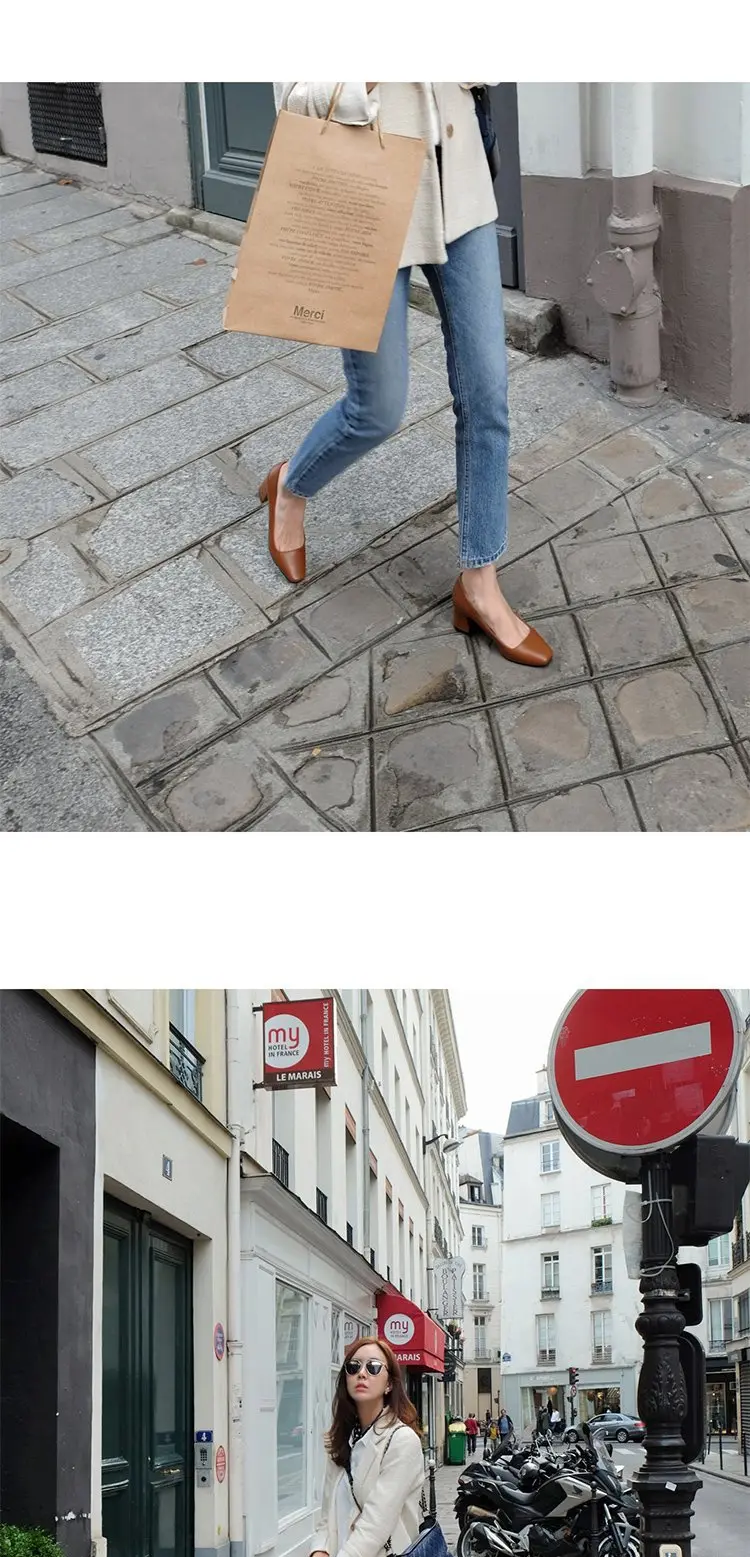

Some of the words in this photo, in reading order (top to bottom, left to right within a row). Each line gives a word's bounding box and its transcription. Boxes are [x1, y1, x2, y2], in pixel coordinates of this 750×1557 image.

[293, 305, 326, 320] Merci
[268, 1027, 300, 1049] my
[276, 1073, 287, 1081] LE
[287, 1071, 322, 1081] MARAIS
[390, 1320, 409, 1334] my
[395, 1353, 421, 1361] ARAIS
[201, 1432, 208, 1442] 4
